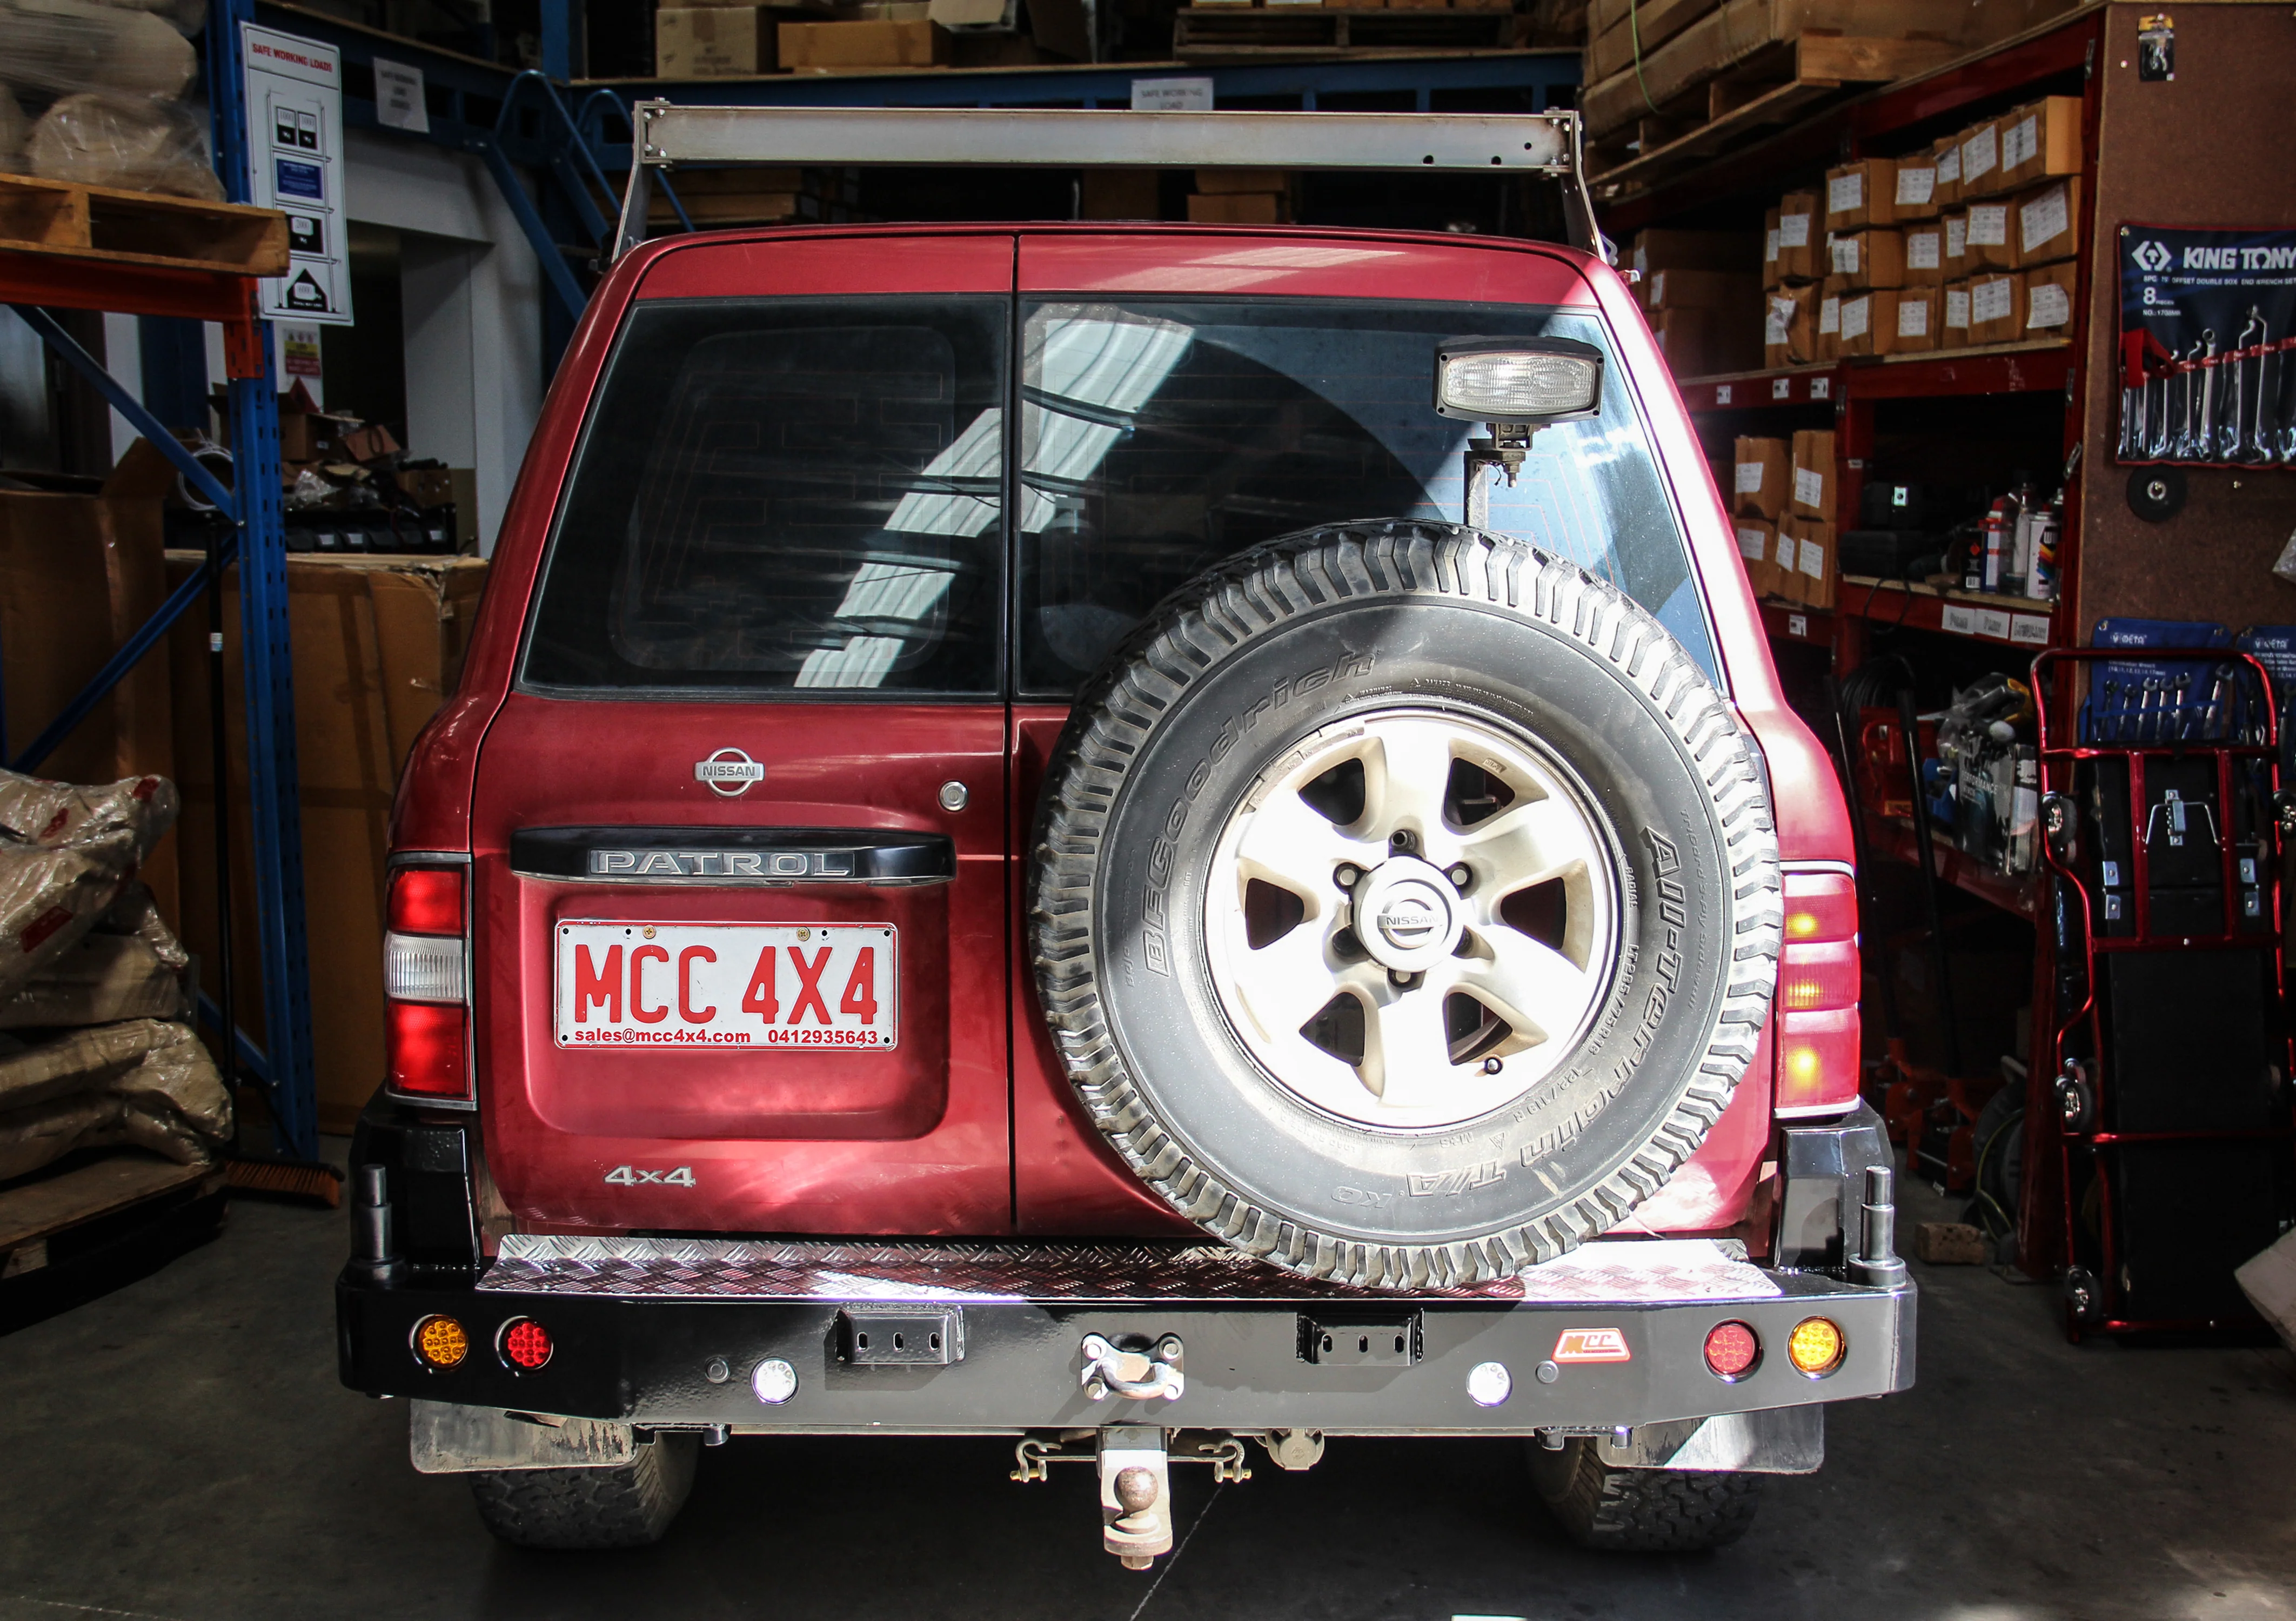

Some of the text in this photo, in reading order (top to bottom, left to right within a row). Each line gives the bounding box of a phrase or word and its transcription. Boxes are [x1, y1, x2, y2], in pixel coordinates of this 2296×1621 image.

[252, 43, 332, 72] SAFE WORKING LOADS
[2183, 247, 2296, 269] KING TONY
[2143, 287, 2156, 305] 8
[702, 765, 757, 777] NISSAN
[1142, 650, 1377, 977] BFGoodrich
[598, 851, 849, 876] PATROL
[1624, 866, 1639, 909] RADIAL
[1387, 916, 1438, 925] NISSAN
[574, 944, 878, 1026] MCC 4X4
[1406, 825, 1686, 1197] All-Terrain T/A
[574, 1028, 878, 1044] sales@mcc4x4.com 0412935643
[1440, 1131, 1474, 1149] M+S
[604, 1165, 697, 1187] 4x4
[1559, 1335, 1619, 1354] MCC
